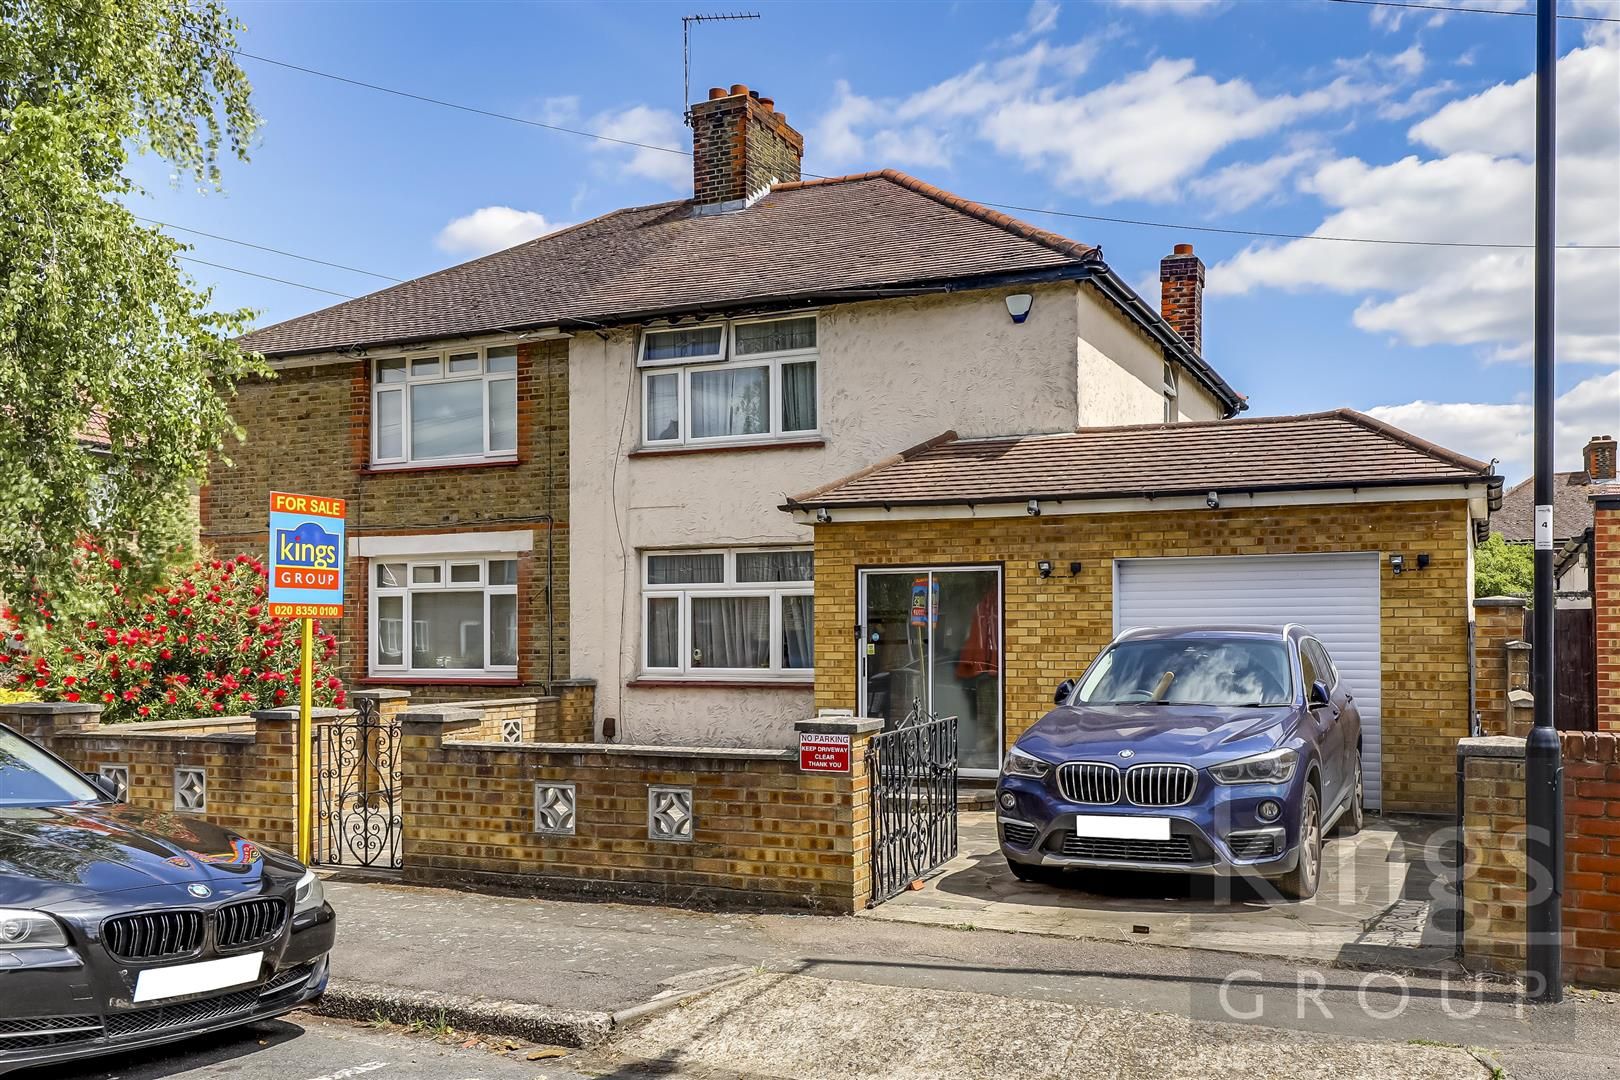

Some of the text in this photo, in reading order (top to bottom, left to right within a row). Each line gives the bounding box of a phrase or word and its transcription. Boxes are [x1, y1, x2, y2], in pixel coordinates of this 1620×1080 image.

[276, 496, 340, 516] FOR SALE
[280, 533, 336, 569] kings
[281, 572, 334, 585] GROUP
[275, 605, 338, 616] 020 8350 0100
